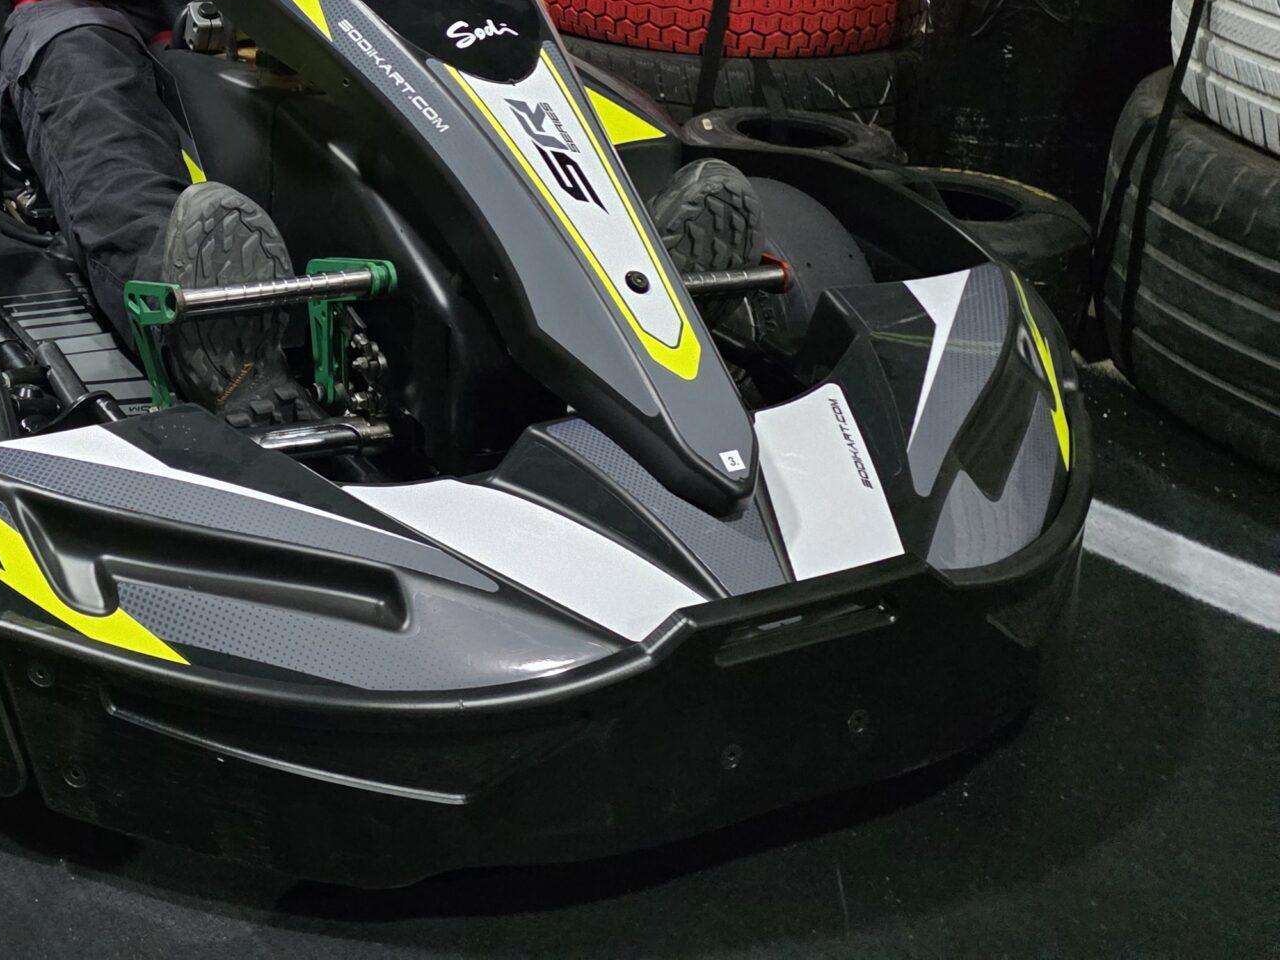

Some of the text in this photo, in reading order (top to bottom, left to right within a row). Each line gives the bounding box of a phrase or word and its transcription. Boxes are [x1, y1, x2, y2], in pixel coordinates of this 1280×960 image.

[446, 19, 519, 49] Sodi
[337, 19, 450, 133] SODIKART.COM
[539, 102, 581, 154] SERIES
[828, 398, 874, 490] SODIKART.COM
